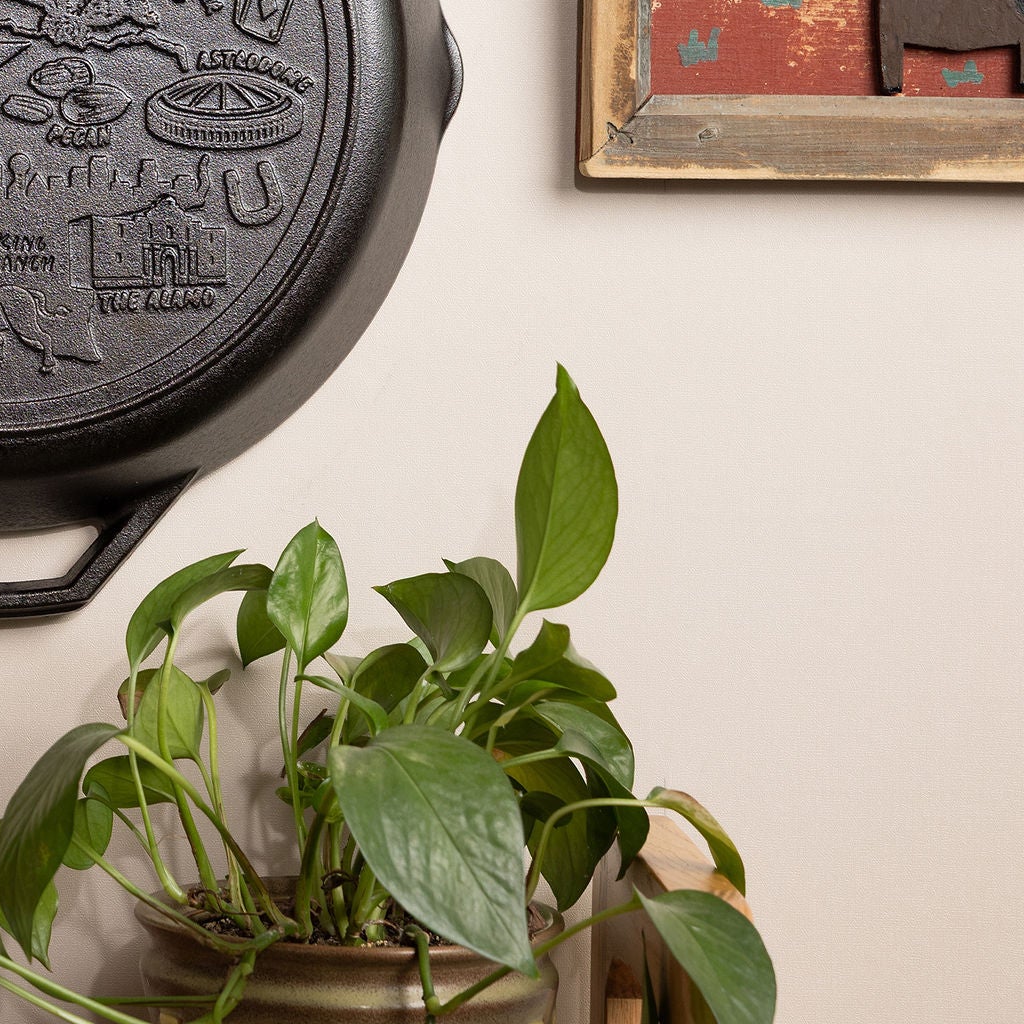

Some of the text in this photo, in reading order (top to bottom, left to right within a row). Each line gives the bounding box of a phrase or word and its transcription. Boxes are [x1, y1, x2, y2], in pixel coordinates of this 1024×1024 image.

[196, 49, 314, 94] ASTRODOME
[46, 124, 112, 148] PECAN
[96, 287, 215, 314] THE ALAMO
